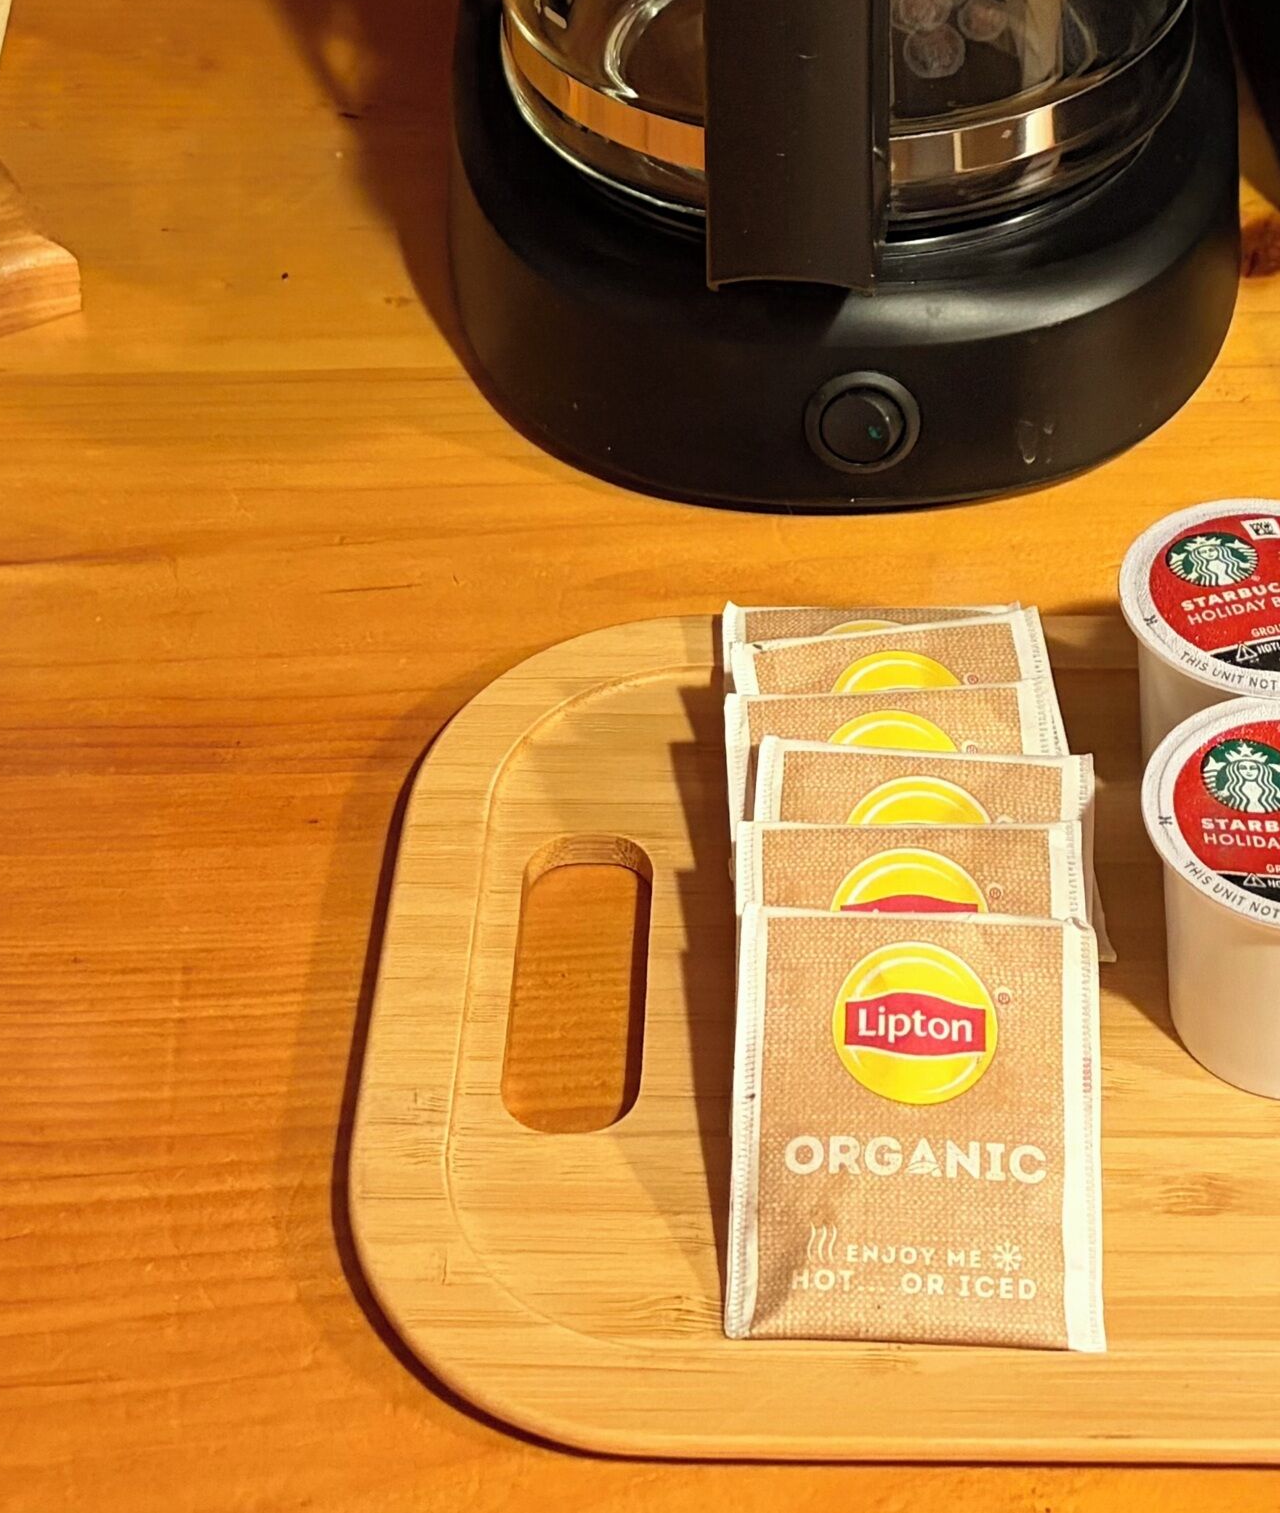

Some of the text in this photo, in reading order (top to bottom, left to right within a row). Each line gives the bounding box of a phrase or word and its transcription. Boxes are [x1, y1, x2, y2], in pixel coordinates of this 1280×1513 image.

[1188, 600, 1266, 625] HOLIDAY
[1179, 651, 1207, 672] THIS
[1212, 668, 1244, 685] UNIT
[1248, 677, 1277, 690] NOT
[1184, 861, 1213, 886] THIS
[1213, 882, 1243, 905] UNIT
[1249, 901, 1280, 919] NOT
[857, 1007, 974, 1042] Lipton
[784, 1135, 1048, 1184] ORGANIC
[847, 1244, 982, 1268] ENJOY ME
[901, 1272, 944, 1295] OR
[959, 1275, 1037, 1300] ICED
